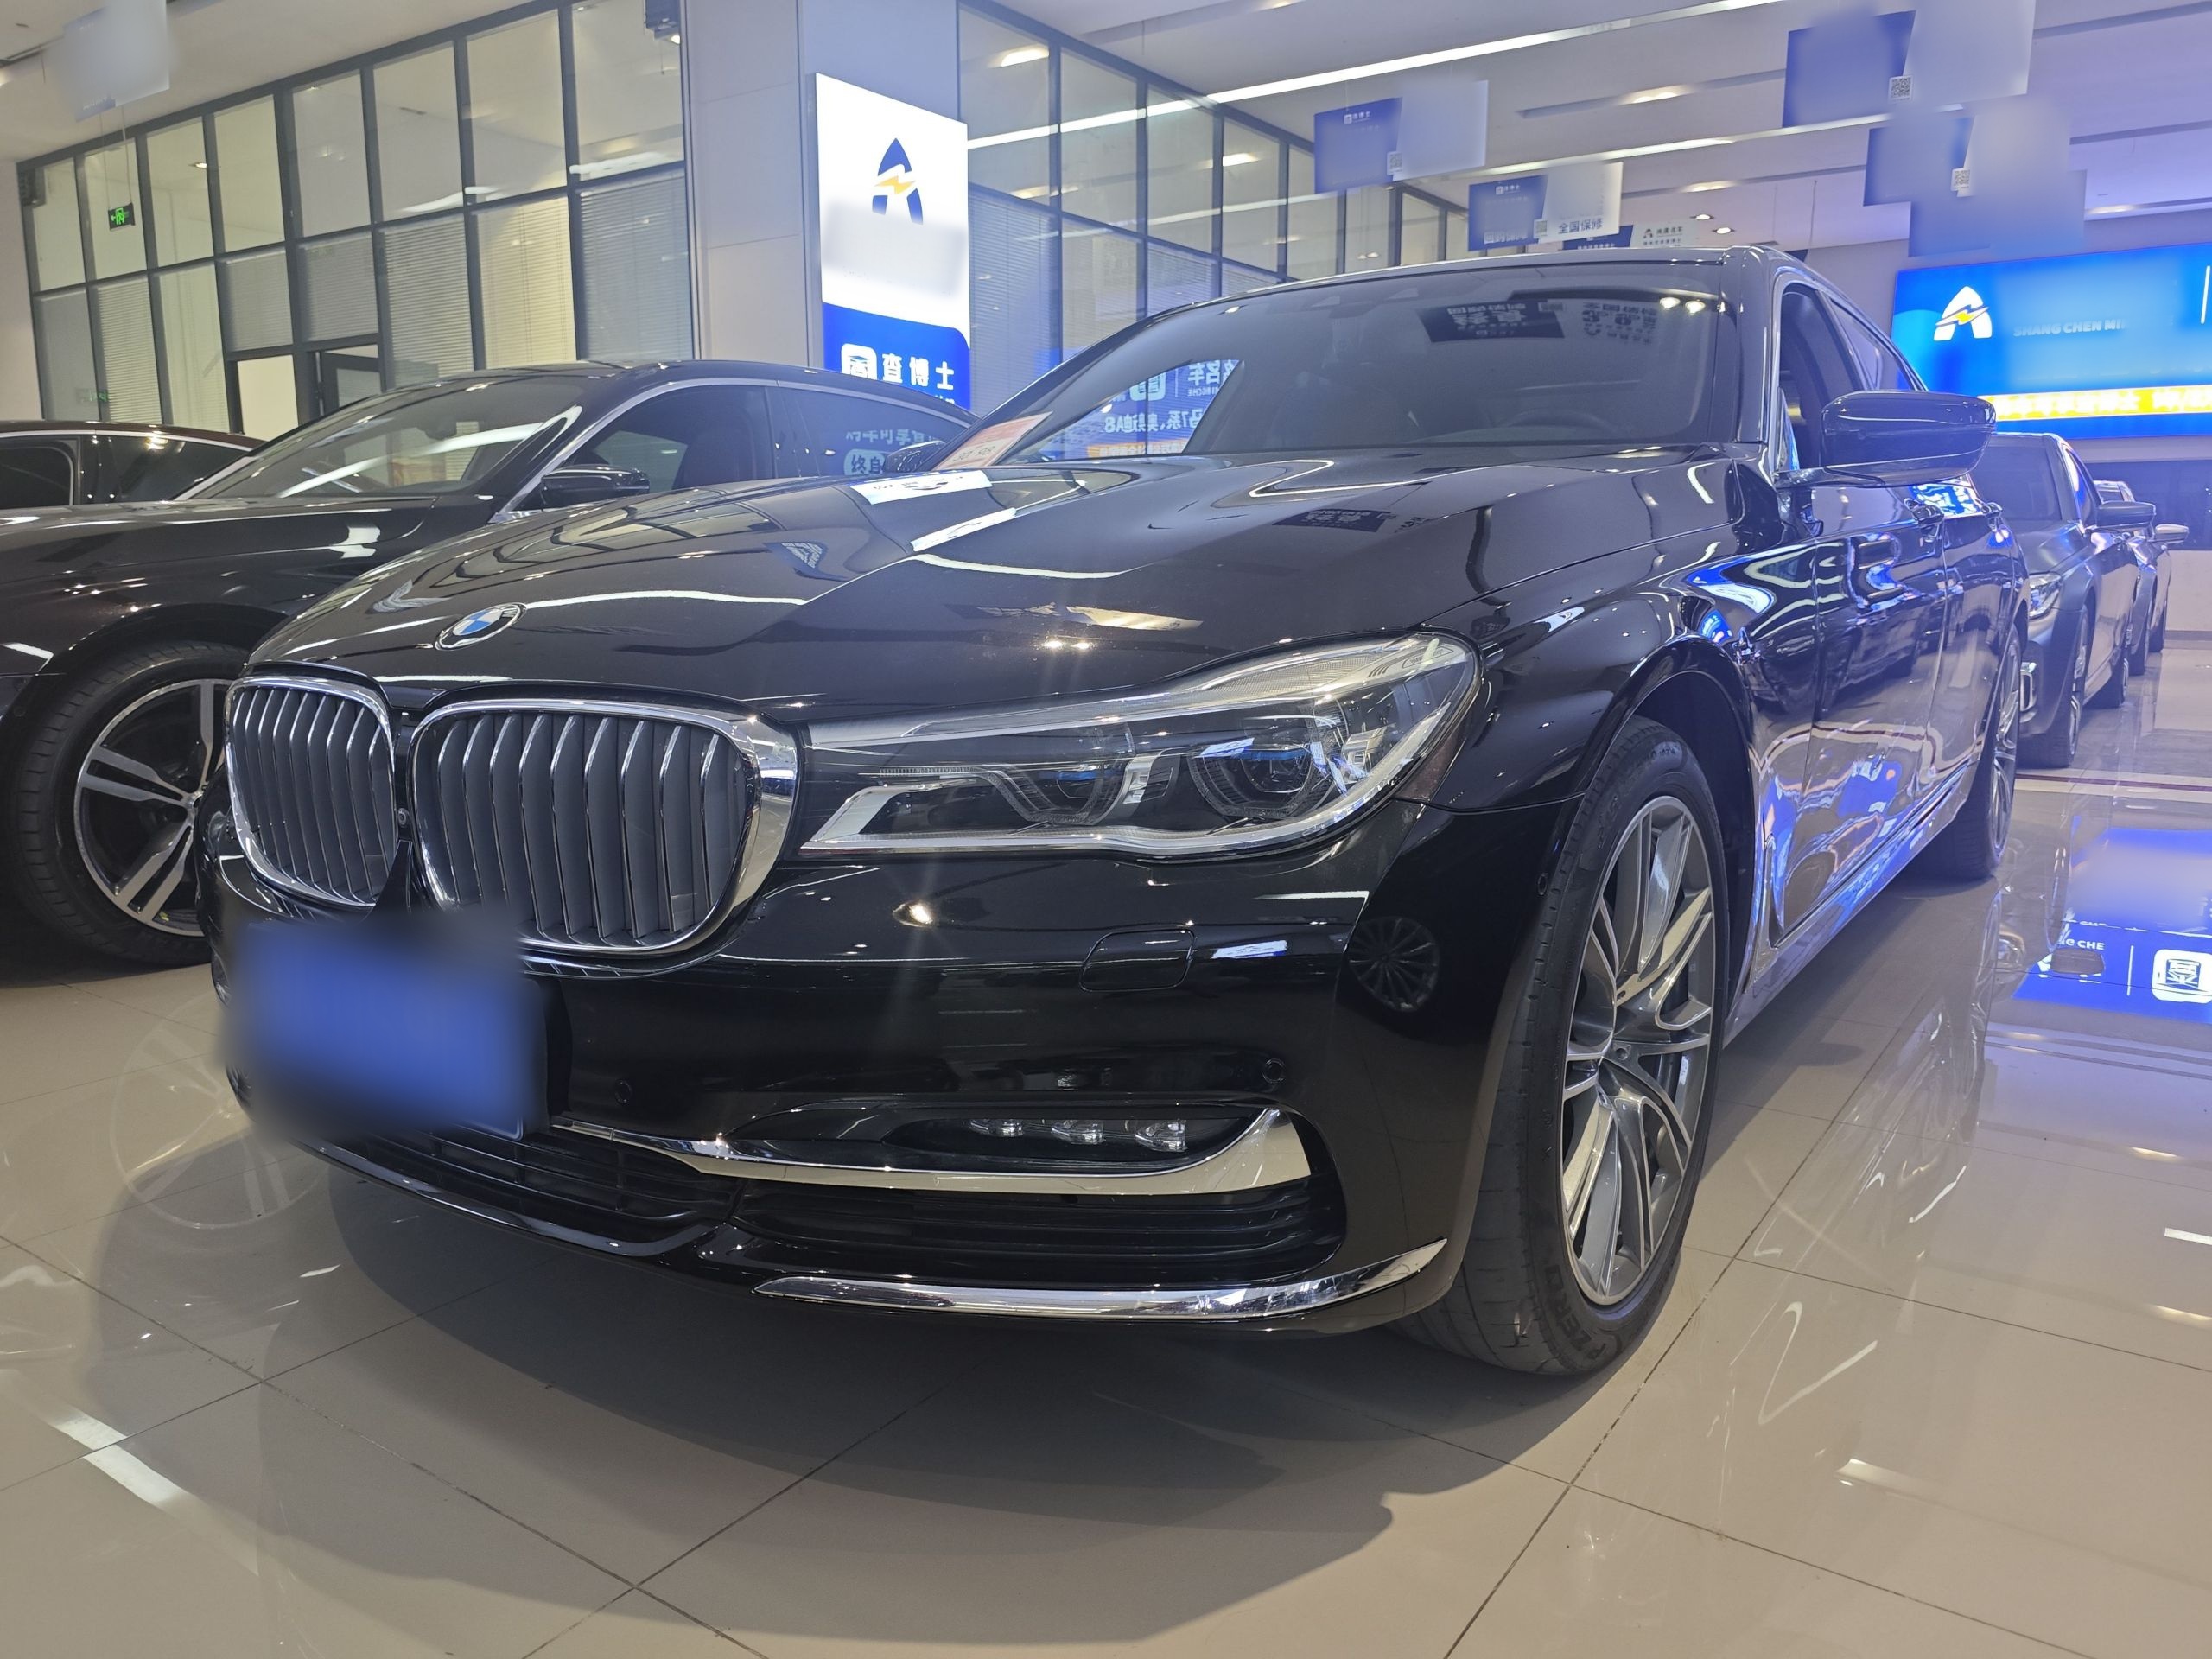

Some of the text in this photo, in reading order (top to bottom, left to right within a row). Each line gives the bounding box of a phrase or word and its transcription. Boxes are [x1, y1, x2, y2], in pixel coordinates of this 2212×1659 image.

[1558, 217, 1604, 235] 全国保修
[2013, 323, 2062, 337] SHANG
[2063, 320, 2102, 334] CHEN
[881, 353, 955, 391] 查博士
